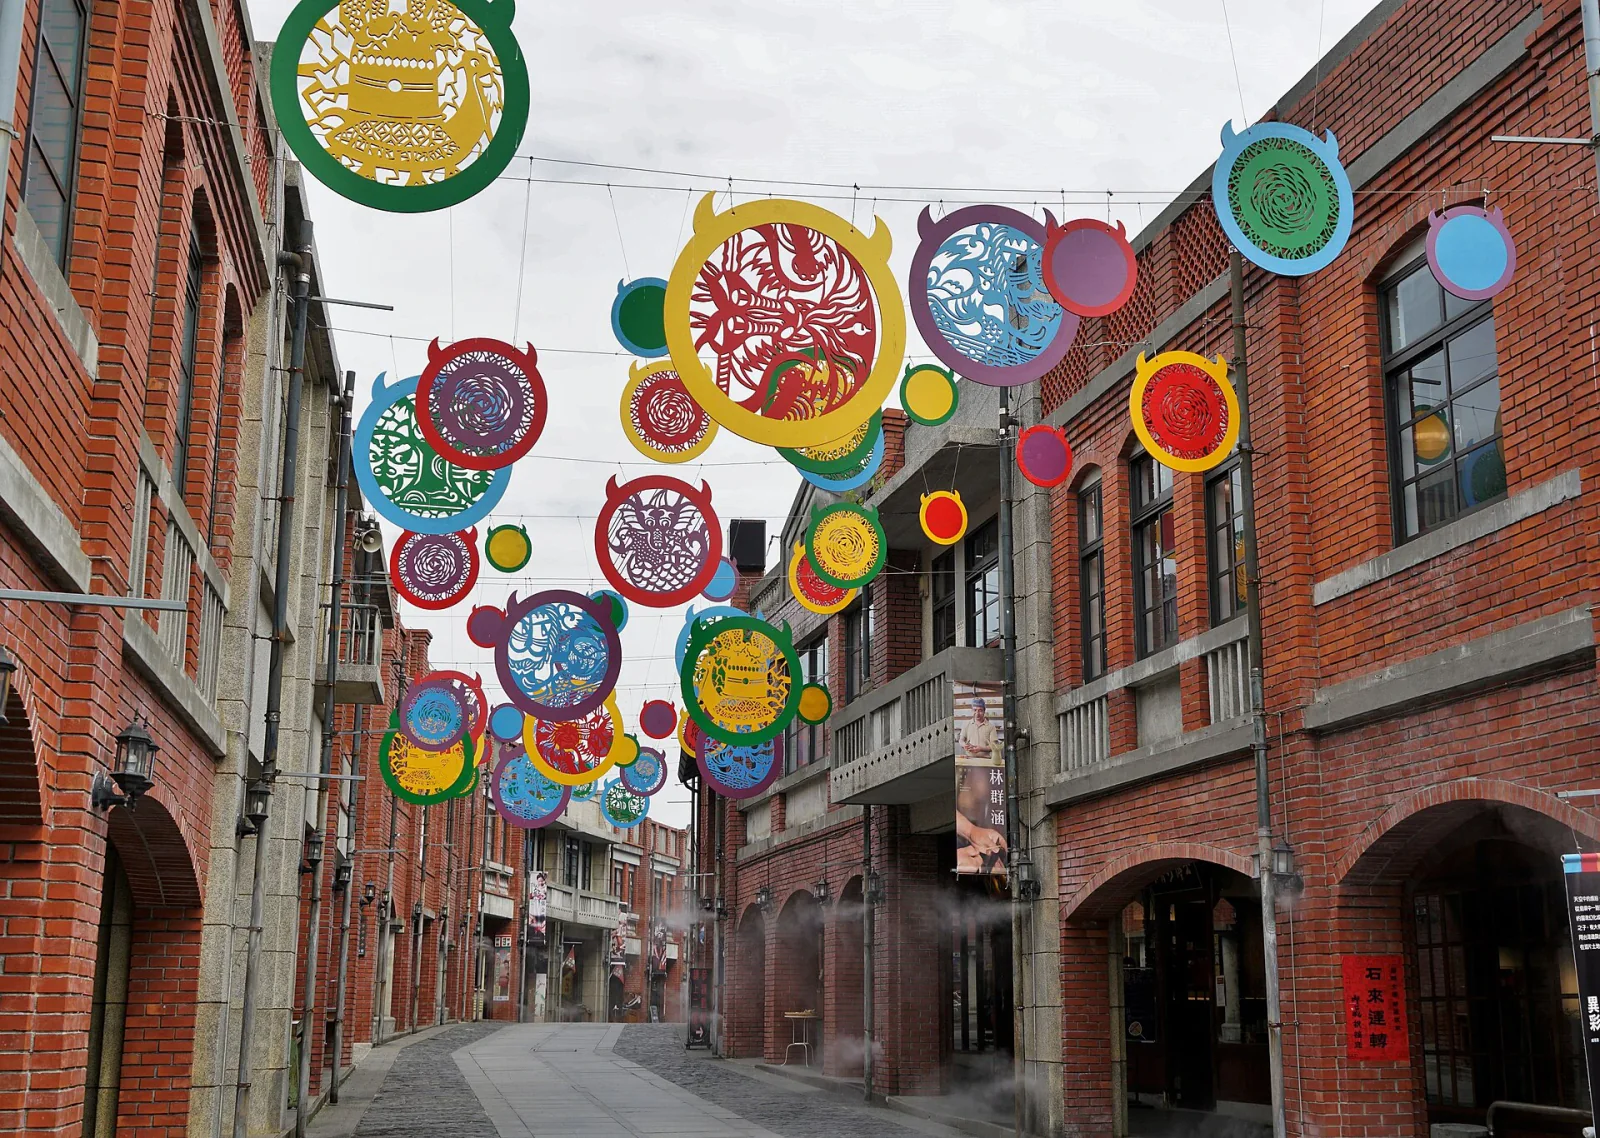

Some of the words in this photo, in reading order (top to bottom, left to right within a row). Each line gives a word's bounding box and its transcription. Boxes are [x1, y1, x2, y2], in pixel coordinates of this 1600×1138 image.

[989, 769, 1004, 825] 林群涵
[1365, 967, 1387, 1048] 石來運轉
